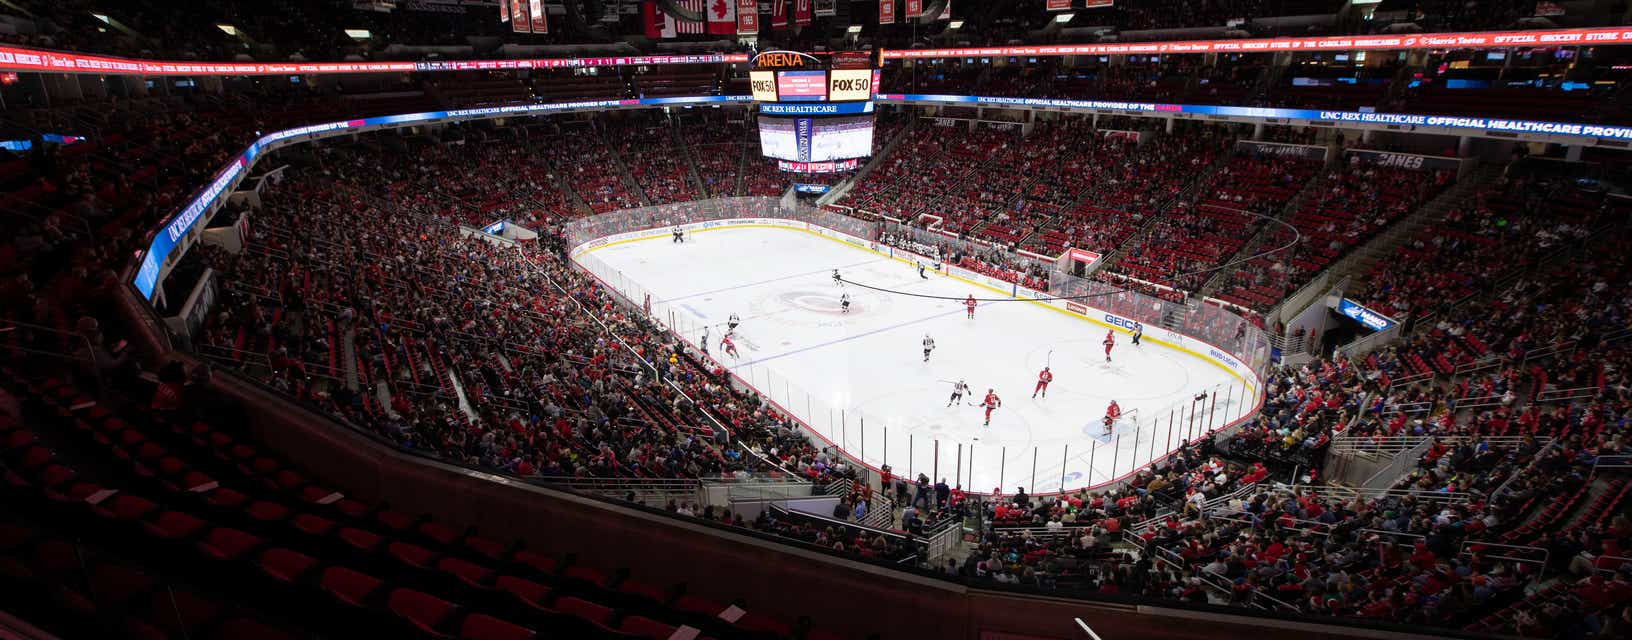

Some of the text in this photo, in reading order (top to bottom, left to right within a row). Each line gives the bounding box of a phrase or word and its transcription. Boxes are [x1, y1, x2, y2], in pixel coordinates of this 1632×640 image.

[1540, 33, 1582, 41] GROCERY
[1585, 32, 1619, 40] STORE
[758, 53, 803, 66] ARENA
[753, 80, 766, 92] FOX
[765, 80, 775, 92] 50
[832, 79, 855, 91] FOX
[855, 79, 869, 91] 50
[529, 103, 568, 111] HEALTHCARE
[786, 105, 838, 113] HEALTHCARE
[1052, 99, 1092, 107] HEALTHCARE
[1093, 101, 1127, 109] PROVIDER
[1320, 111, 1341, 120] UNC
[1341, 112, 1360, 120] REX
[1361, 113, 1425, 125] HEALTHCARE
[1427, 117, 1485, 128] OFFICIAL
[1487, 119, 1582, 134] HEALTHCARE
[1376, 153, 1424, 168] CANES
[1361, 311, 1387, 327] MAKO
